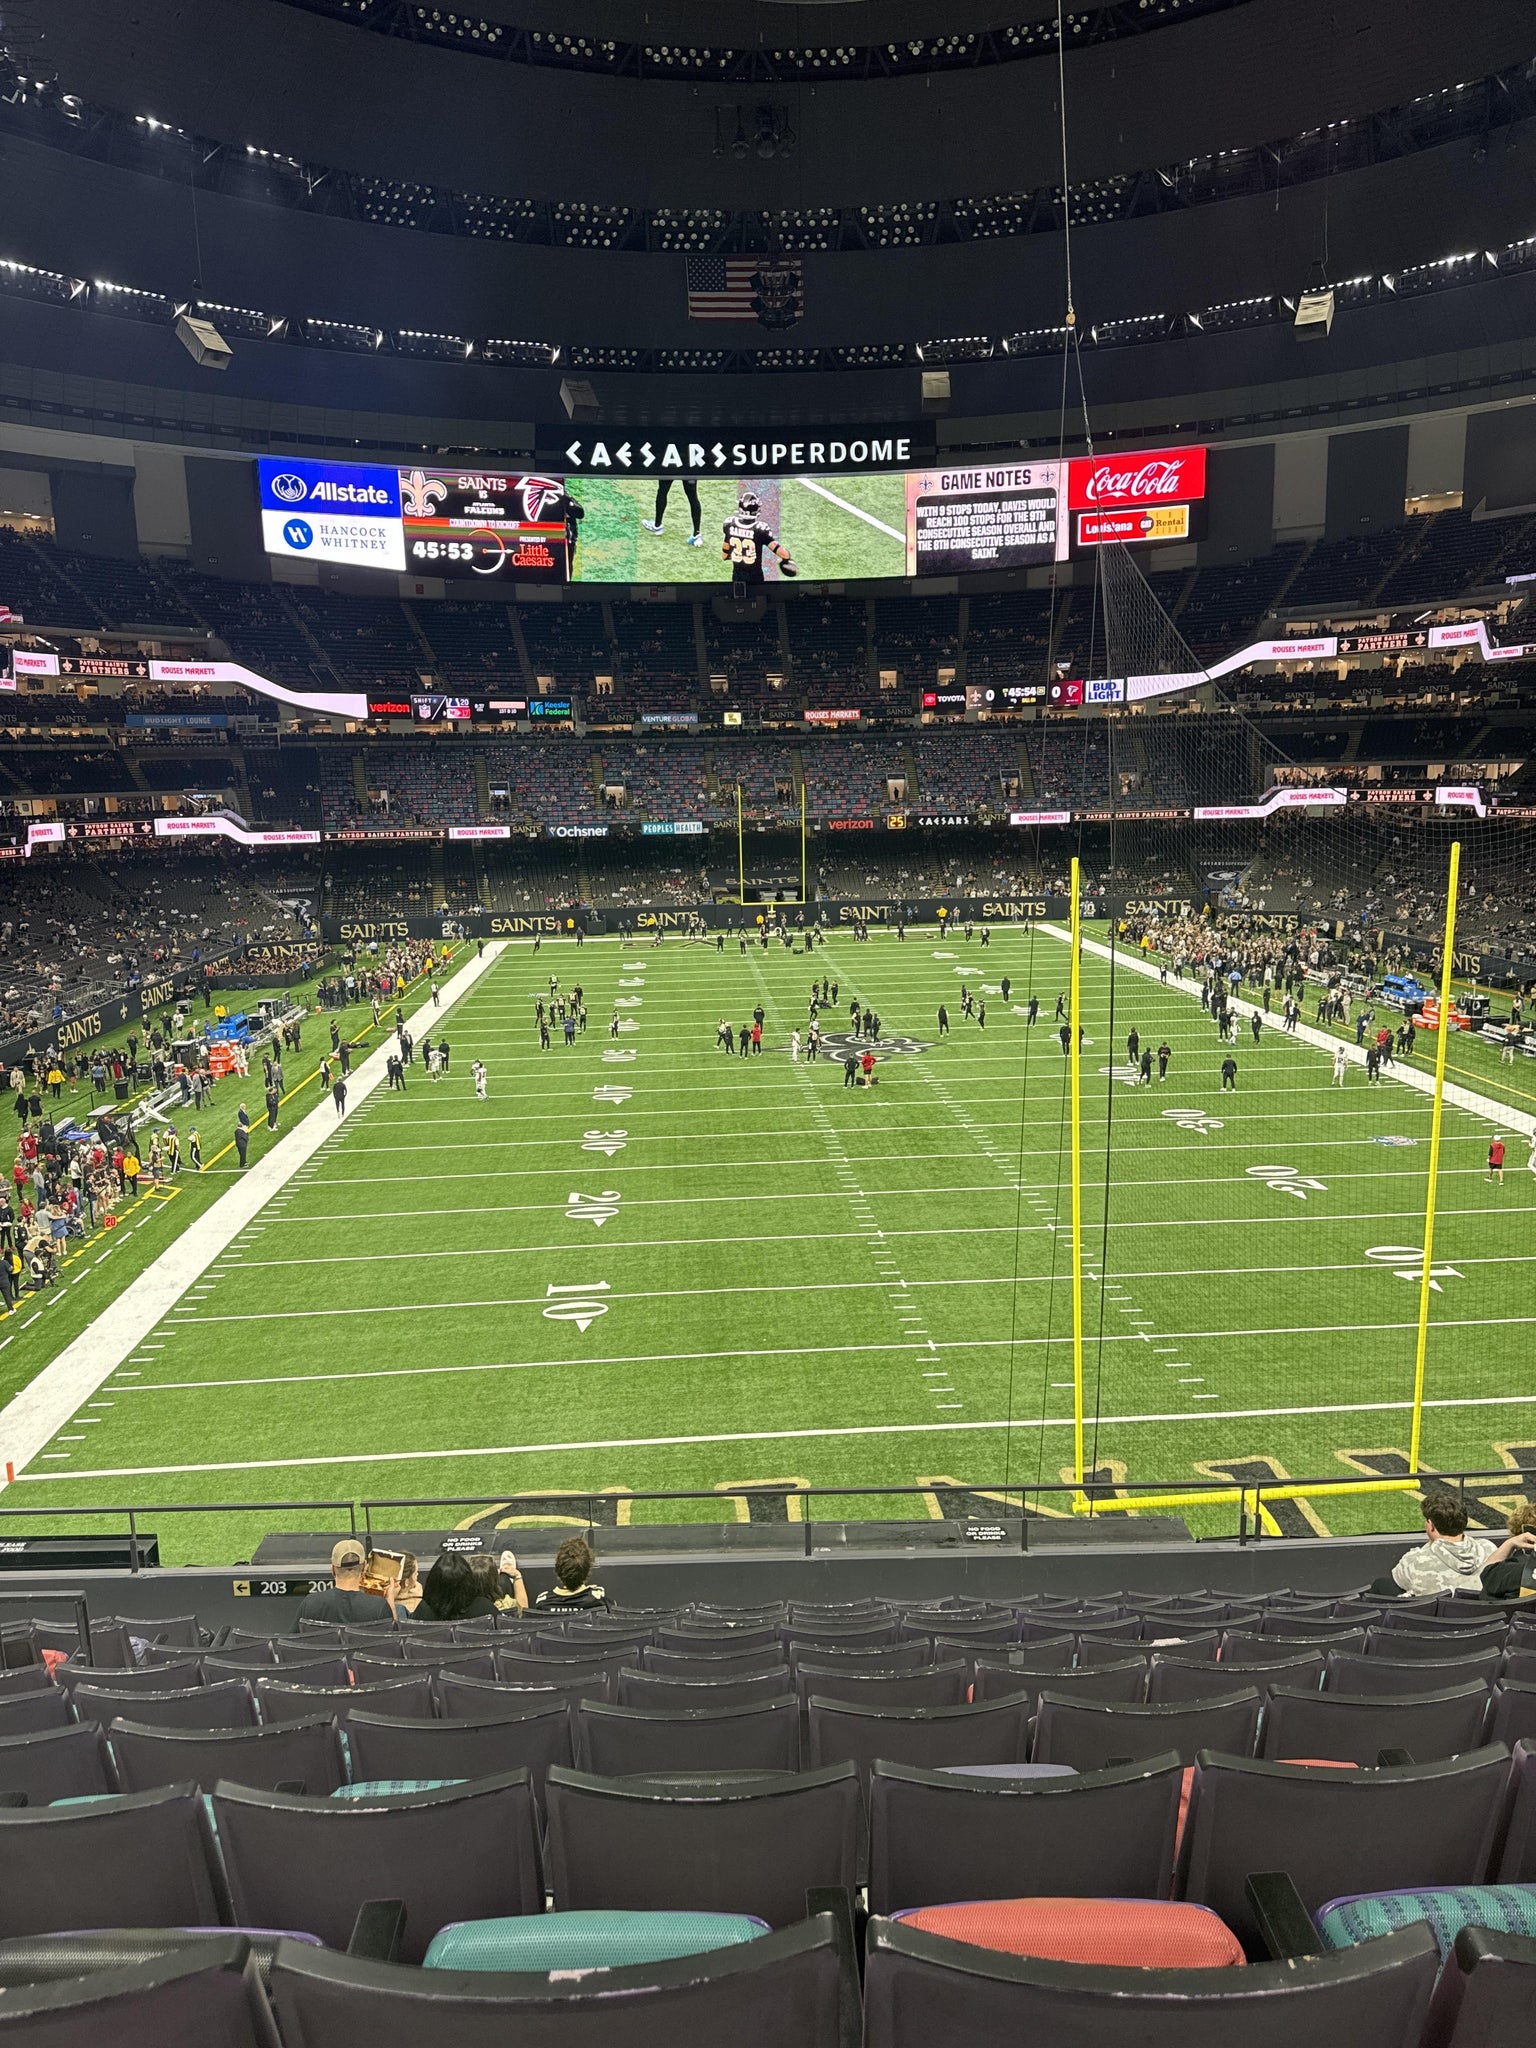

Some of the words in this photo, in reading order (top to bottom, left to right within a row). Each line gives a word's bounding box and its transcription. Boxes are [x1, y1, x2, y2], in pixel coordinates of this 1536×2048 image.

[565, 440, 728, 467] CAESARS
[733, 438, 911, 466] SUPERDOME
[458, 476, 507, 491] SAINTS
[941, 473, 982, 490] GAME
[986, 469, 1032, 487] NOTES
[309, 481, 389, 504] Allstate
[917, 505, 939, 517] WITH
[939, 505, 945, 515] 9
[947, 503, 972, 515] STOPS
[972, 502, 1000, 514] TODAY,
[1002, 500, 1027, 512] DAVIS
[1028, 498, 1056, 509] WOULD
[926, 516, 952, 528] REACH
[953, 515, 969, 526] 100
[970, 514, 995, 525] STOPS
[996, 512, 1012, 523] FOR
[1013, 511, 1028, 522] THE
[1030, 510, 1046, 521] 9TH
[1156, 518, 1184, 527] Rental
[320, 525, 387, 537] HANCOCK
[917, 526, 971, 539] CONSECUTIVE
[971, 524, 1002, 537] SEASON
[1004, 522, 1037, 534] OVERALL
[1038, 520, 1055, 532] AND
[1086, 522, 1133, 535] Louisiana
[320, 537, 387, 549] WHITNEY
[918, 540, 933, 551] THE
[933, 538, 950, 550] 8TH
[950, 536, 1004, 549] CONSECUTIVE
[1005, 534, 1036, 546] SEASON
[1037, 533, 1048, 544] AS
[1049, 532, 1055, 543] A
[413, 541, 473, 560] 45:53
[519, 544, 549, 557] Little
[729, 537, 757, 564] 33
[971, 547, 999, 560] SAINT.
[512, 554, 554, 567] Caesars
[1441, 630, 1462, 640] ROUSES
[1272, 645, 1296, 653] ROUSES
[1297, 644, 1325, 652] MARKETS
[1357, 640, 1408, 650] PARTNERS
[79, 665, 130, 675] PARTNERS
[161, 667, 183, 675] ROUSES
[185, 667, 215, 675] MARKETS
[1008, 687, 1037, 697] 45:54
[1052, 686, 1061, 698] 0
[1092, 682, 1117, 691] BUD
[986, 689, 995, 702] 0
[1088, 691, 1121, 700] LIGHT
[369, 701, 410, 713] verizon
[544, 701, 571, 709] Keesler
[545, 708, 570, 716] Federal
[805, 711, 830, 719] ROUSES
[830, 710, 859, 719] MARKETS
[186, 717, 211, 725] LOUNGE
[642, 715, 671, 723] VENTURE
[167, 822, 190, 830] ROUSES
[828, 818, 874, 830] verizon
[889, 817, 904, 827] 25
[918, 816, 969, 826] CAESARS
[85, 828, 135, 836] PARTNERS
[513, 825, 542, 833] SAINTS
[556, 825, 608, 837] Ochsner
[643, 824, 673, 834] PEOPLES
[675, 822, 703, 833] HEALTH
[840, 905, 891, 921] SAINT
[983, 902, 1046, 917] SAINTS
[491, 916, 557, 933] SAINTS
[637, 911, 699, 928] SAINTS
[1229, 914, 1299, 930] SNTS
[340, 922, 409, 938] SAINTS
[248, 942, 318, 958] SAINTS
[1432, 947, 1481, 975] SNTS
[141, 979, 175, 1010] SAINTS
[57, 1013, 102, 1049] SAINTS
[592, 1084, 633, 1100] 40
[1161, 1108, 1224, 1130] 30
[581, 1129, 628, 1151] 30
[1245, 1164, 1328, 1192] 20
[565, 1190, 621, 1218] 20
[106, 1217, 116, 1228] 20
[1364, 1245, 1466, 1280] 10
[542, 1280, 612, 1320] 10
[260, 1581, 287, 1594] 203
[308, 1581, 334, 1594] 201
